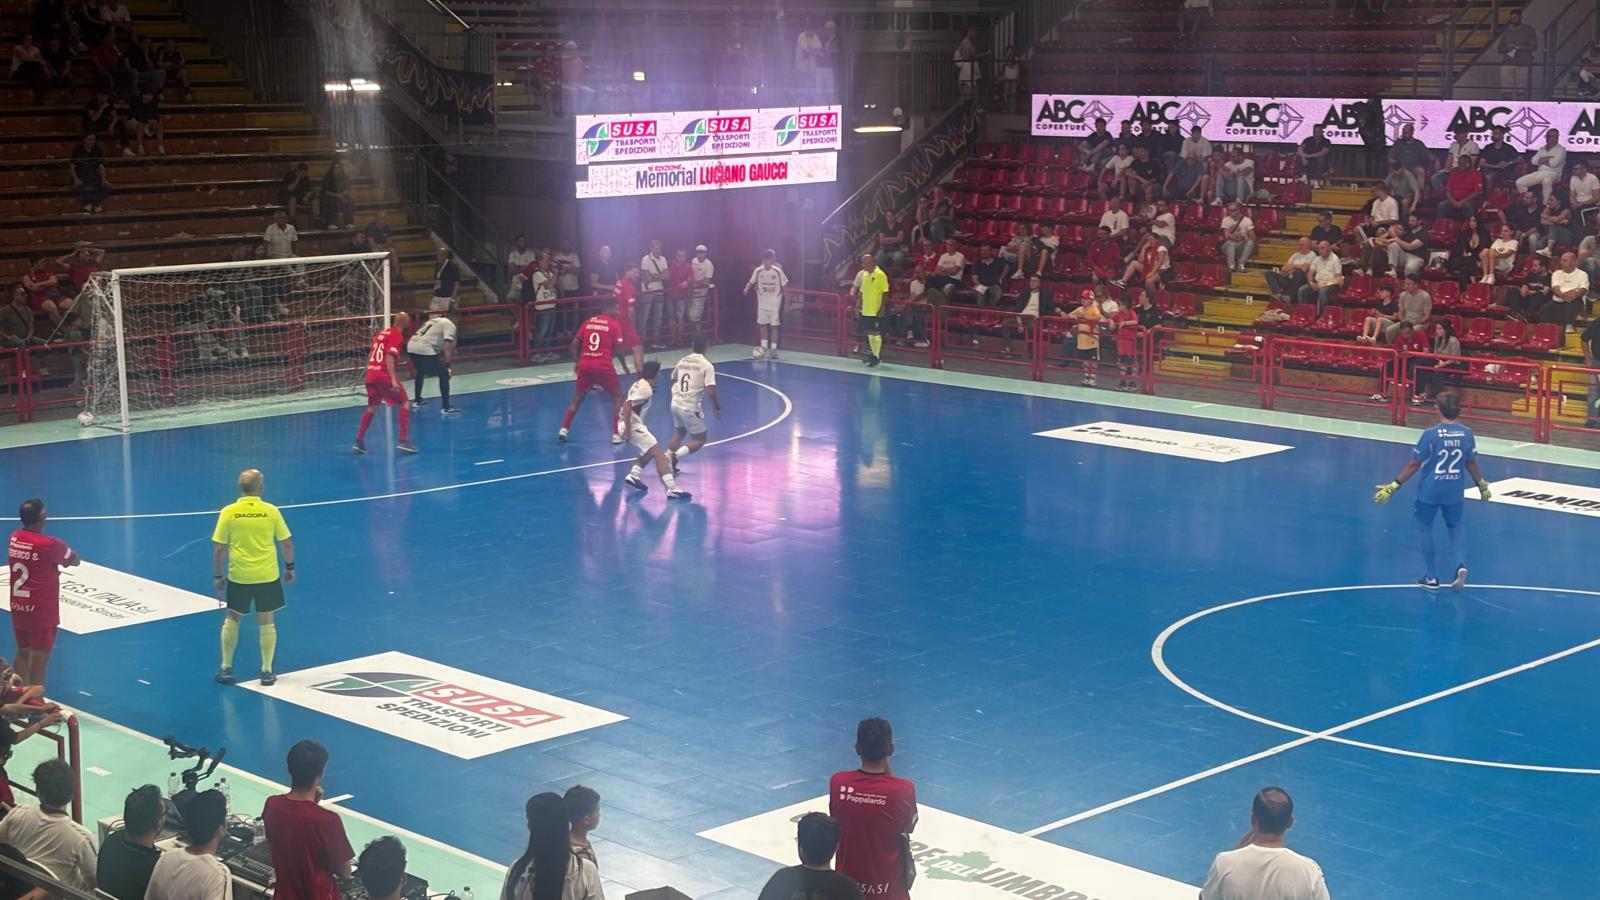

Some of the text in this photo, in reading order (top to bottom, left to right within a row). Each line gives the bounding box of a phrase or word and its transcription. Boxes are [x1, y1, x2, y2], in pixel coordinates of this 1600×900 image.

[799, 114, 837, 127] SUSA
[1036, 100, 1086, 123] ABC
[1130, 101, 1181, 124] ABC
[1226, 103, 1280, 127] ABC
[1322, 104, 1359, 129] AB
[1446, 106, 1513, 133] ABC
[612, 121, 656, 136] SUSA
[710, 119, 750, 132] SUSA
[802, 128, 837, 136] TRASPORTI
[615, 147, 656, 155] SPEDIZIONI
[616, 138, 656, 146] TRASPORTI
[711, 142, 750, 150] SPEDIZIONI
[802, 137, 837, 145] SPEDIZIONI
[636, 161, 788, 189] Memorial LUCIANO GAUCCI
[588, 332, 601, 351] 9
[680, 373, 691, 393] 6
[1435, 449, 1463, 473] 22
[12, 562, 30, 598] 2
[401, 698, 514, 732] TRASPORTI
[422, 688, 553, 724] SUSA
[376, 703, 493, 739] SPEDIZIONI
[846, 794, 886, 806] Pappalardo
